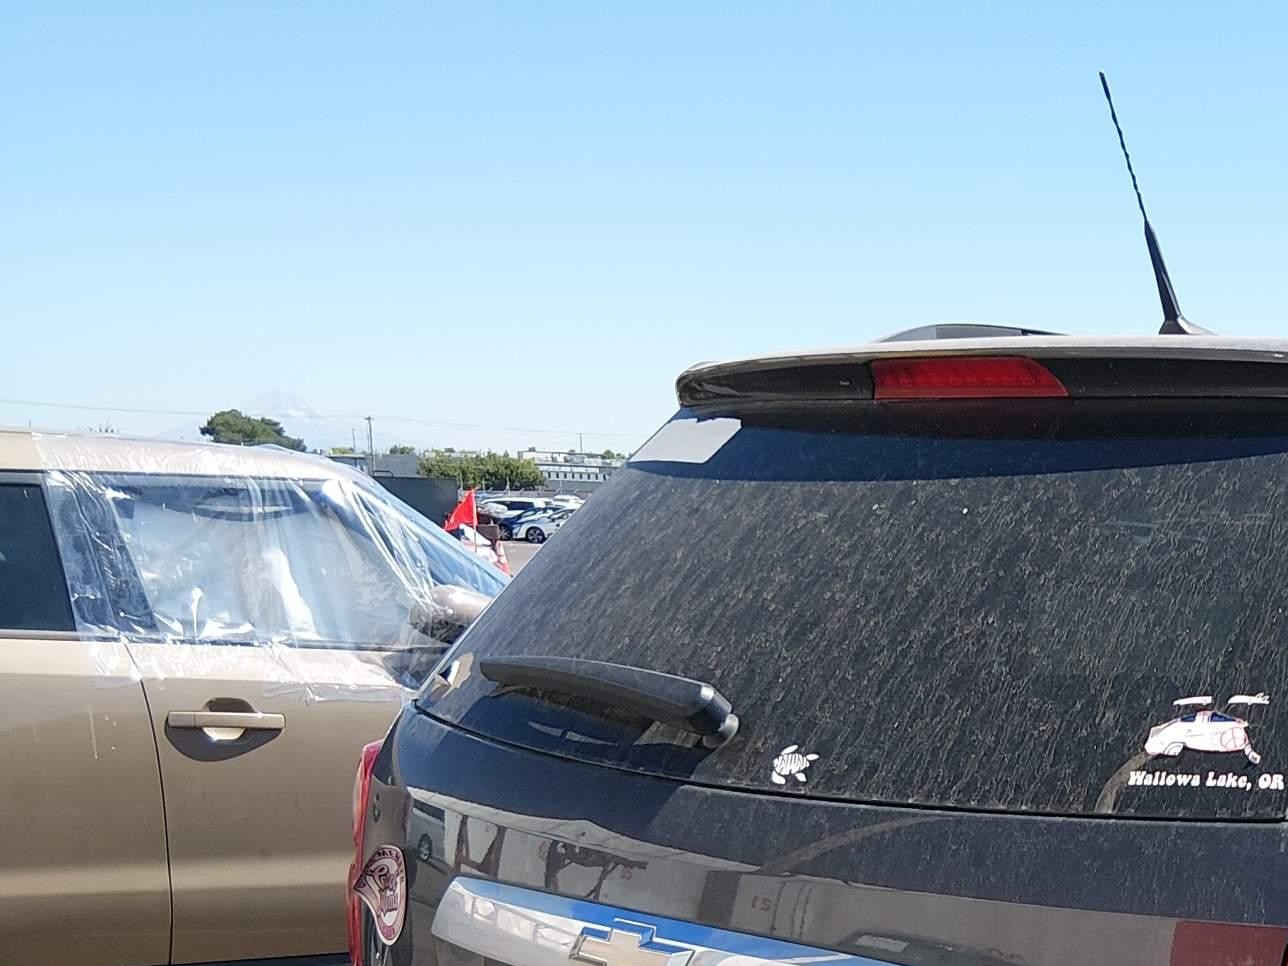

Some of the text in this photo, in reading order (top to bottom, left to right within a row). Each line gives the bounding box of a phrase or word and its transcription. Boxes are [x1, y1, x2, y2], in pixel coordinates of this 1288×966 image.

[1128, 770, 1285, 791] Wallowa Lake, OR
